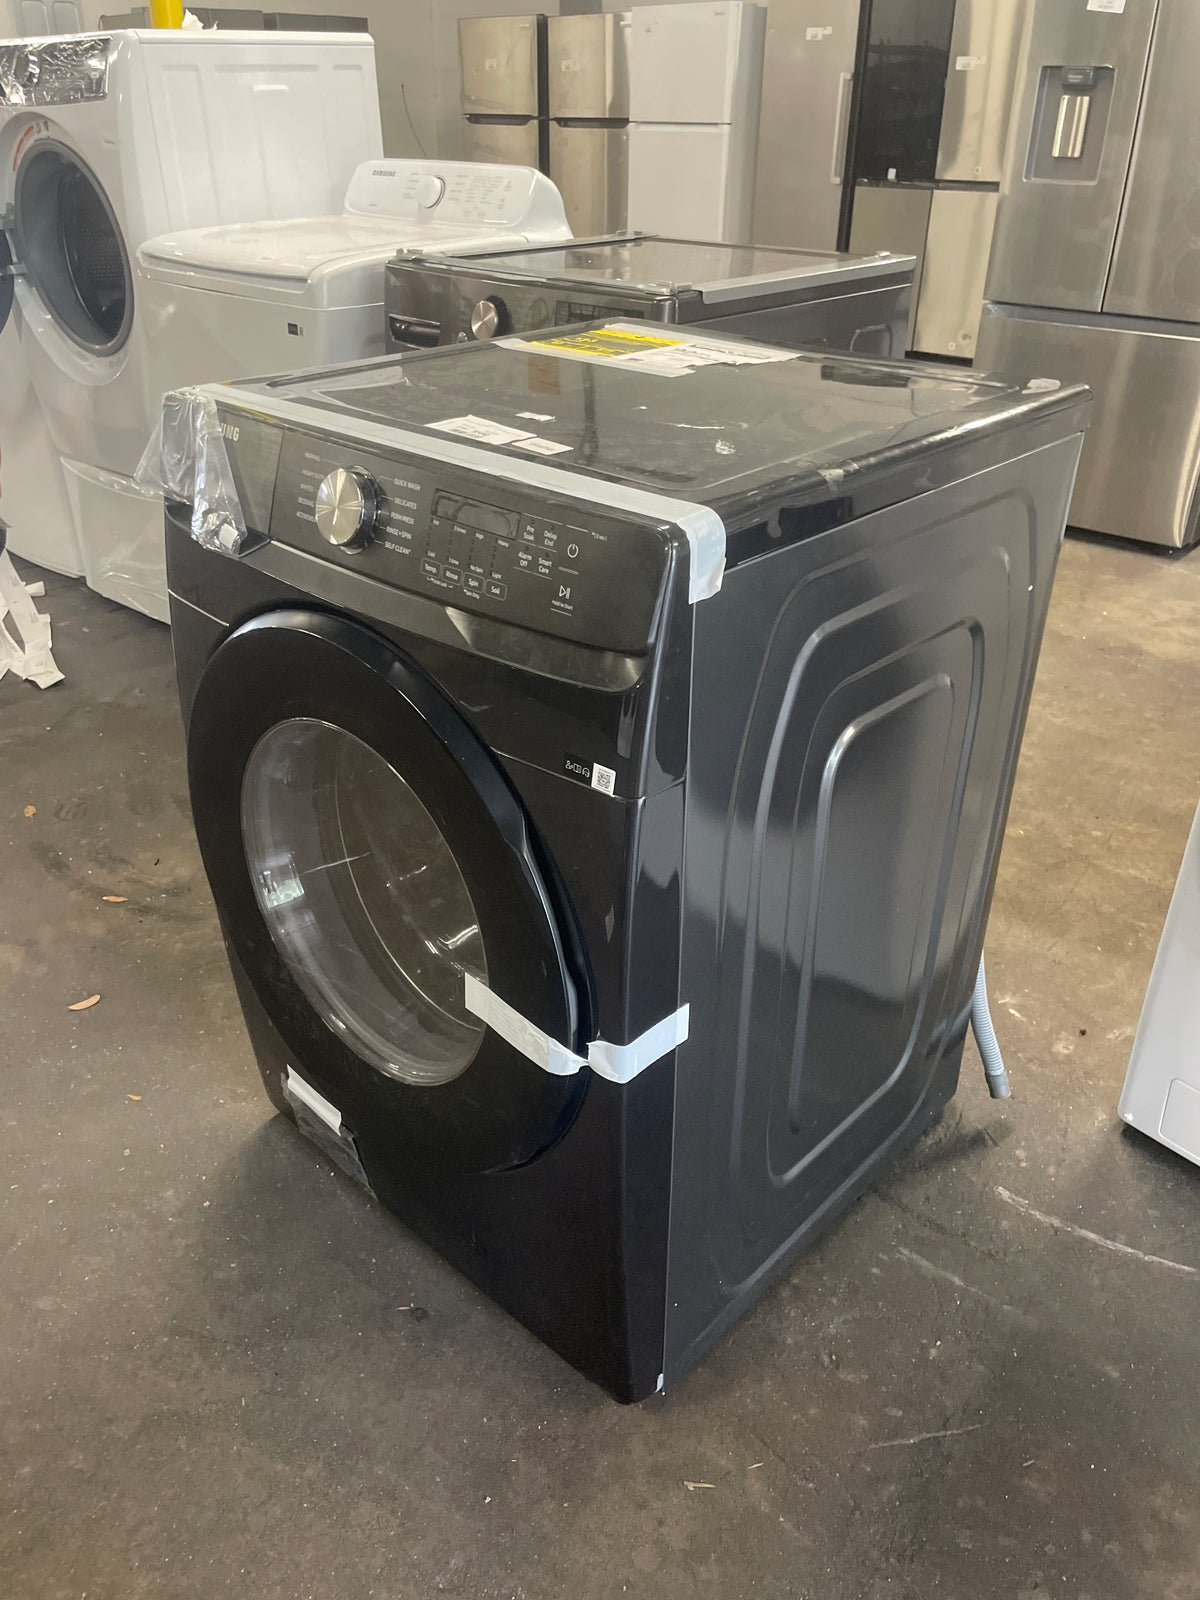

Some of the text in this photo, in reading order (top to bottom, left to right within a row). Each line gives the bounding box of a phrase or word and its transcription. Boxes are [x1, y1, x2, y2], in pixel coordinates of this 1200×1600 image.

[394, 478, 407, 488] QUICK
[394, 498, 417, 510] DELICATES
[526, 525, 534, 533] Pre
[524, 532, 534, 541] Soak
[544, 530, 557, 541] Delay
[384, 542, 395, 550] SELF
[518, 552, 532, 561] Alarm
[538, 557, 552, 567] Smart
[538, 566, 549, 574] Care
[446, 570, 458, 580] Rinse
[468, 578, 478, 587] Spin
[491, 586, 500, 594] Soil
